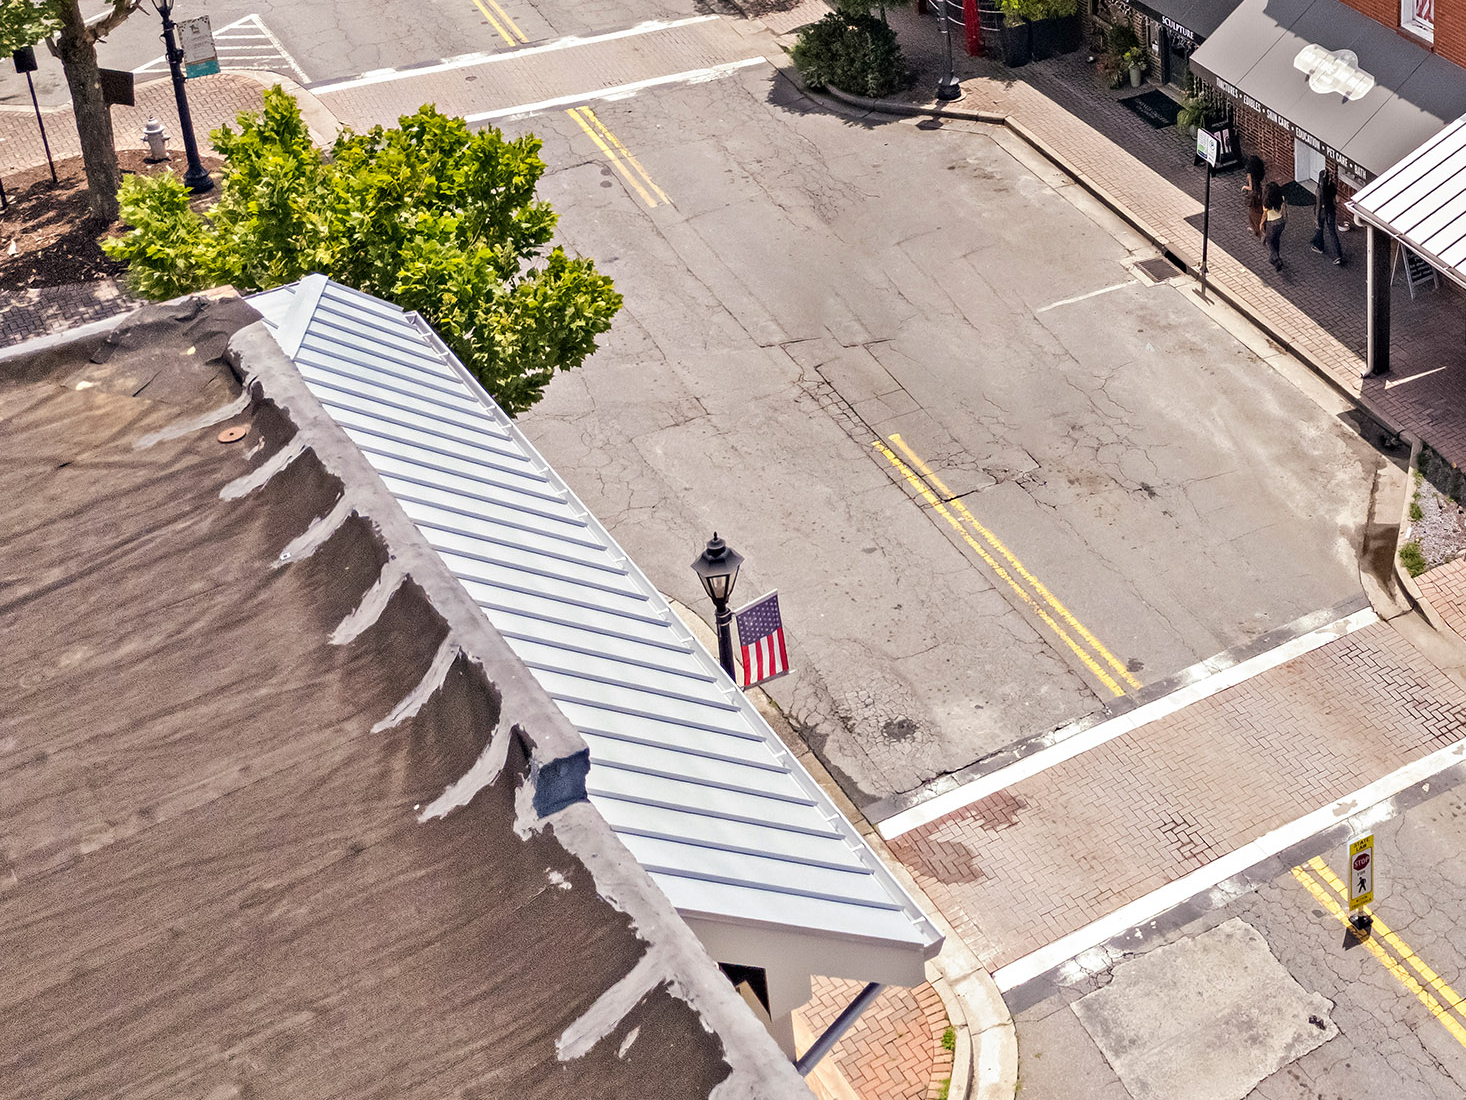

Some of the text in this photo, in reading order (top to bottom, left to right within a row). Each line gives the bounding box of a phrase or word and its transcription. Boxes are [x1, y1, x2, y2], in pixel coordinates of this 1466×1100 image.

[1162, 15, 1194, 40] SCULPTURE
[1277, 115, 1290, 131] CARE
[1295, 126, 1321, 150] EDUCATION
[1326, 146, 1335, 159] PET
[1335, 152, 1348, 168] CARE
[1354, 164, 1367, 180] BATH
[1353, 837, 1369, 848] STATE
[1354, 856, 1369, 867] STOP
